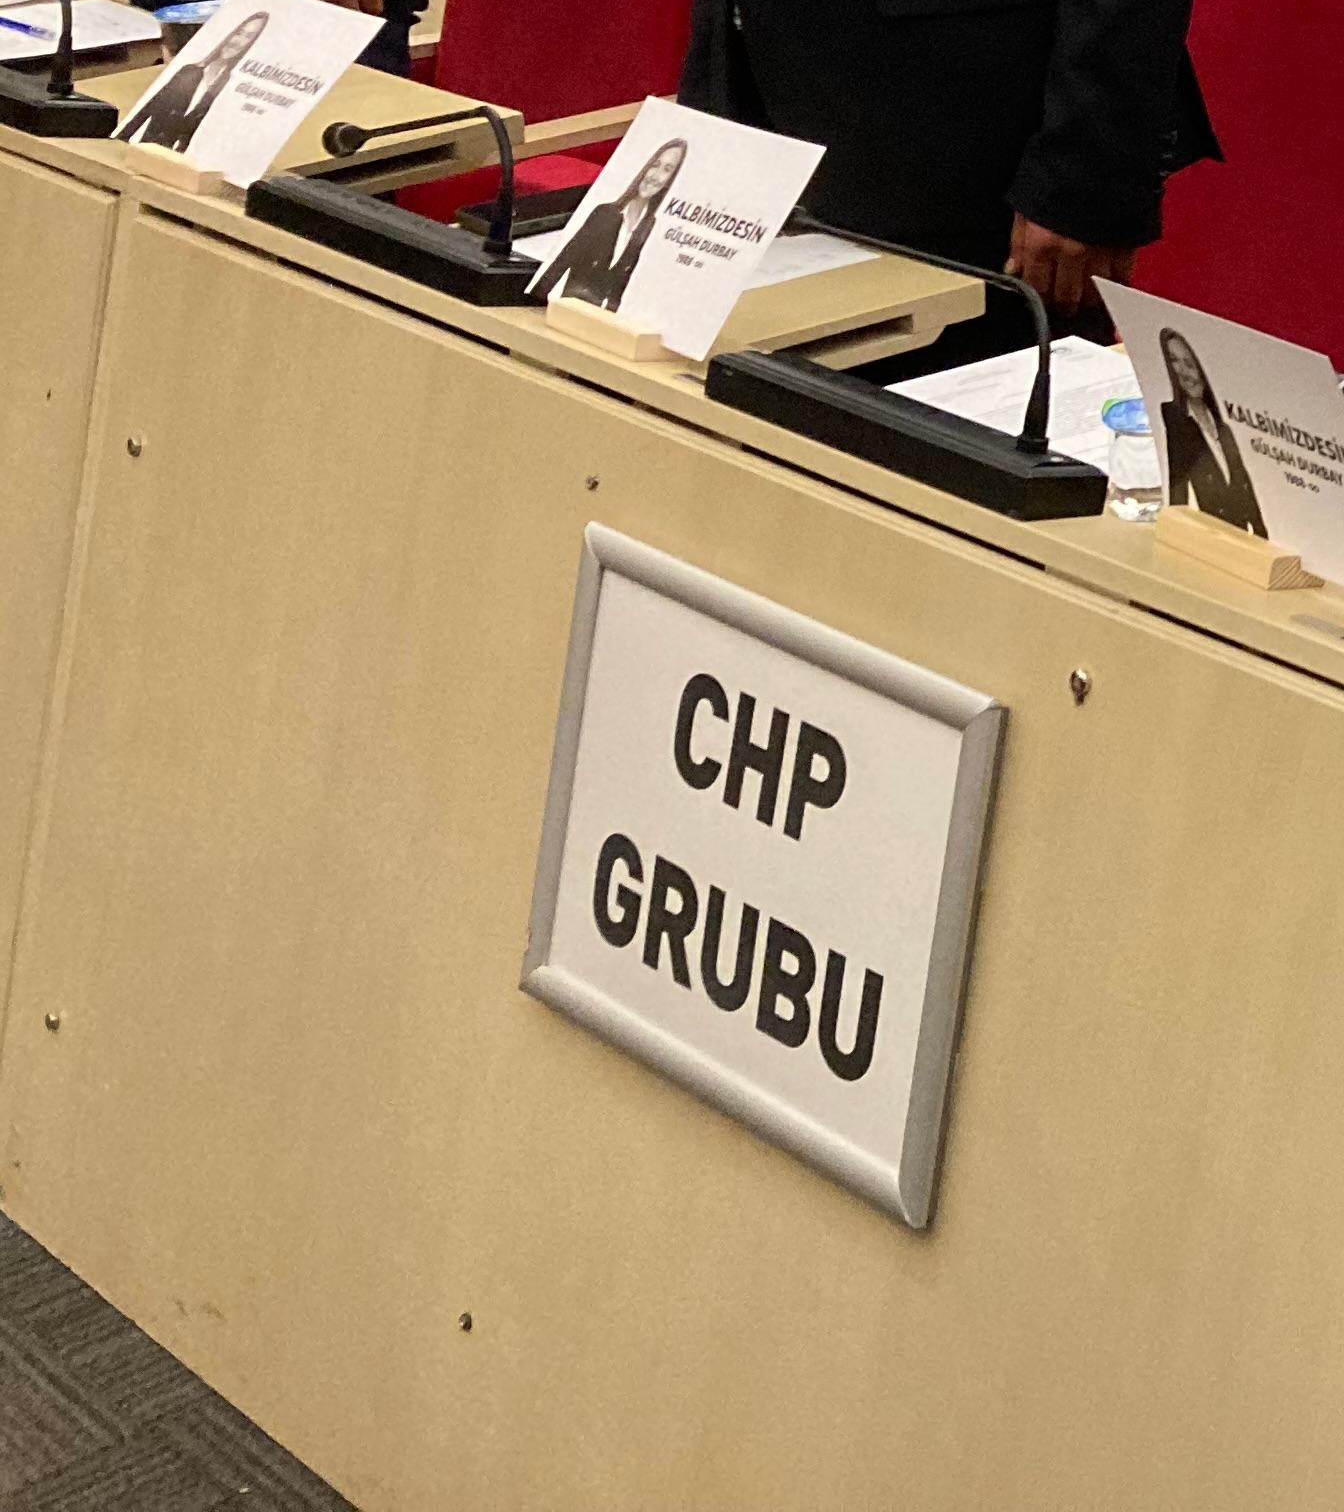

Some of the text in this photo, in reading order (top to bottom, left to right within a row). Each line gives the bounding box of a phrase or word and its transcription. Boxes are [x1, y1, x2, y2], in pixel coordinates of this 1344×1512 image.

[664, 197, 768, 244] KALBİMİZDESİN
[664, 226, 738, 260] GÜLŞAH DURBAY
[674, 673, 847, 841] CHP
[593, 833, 884, 1083] GRUBU
